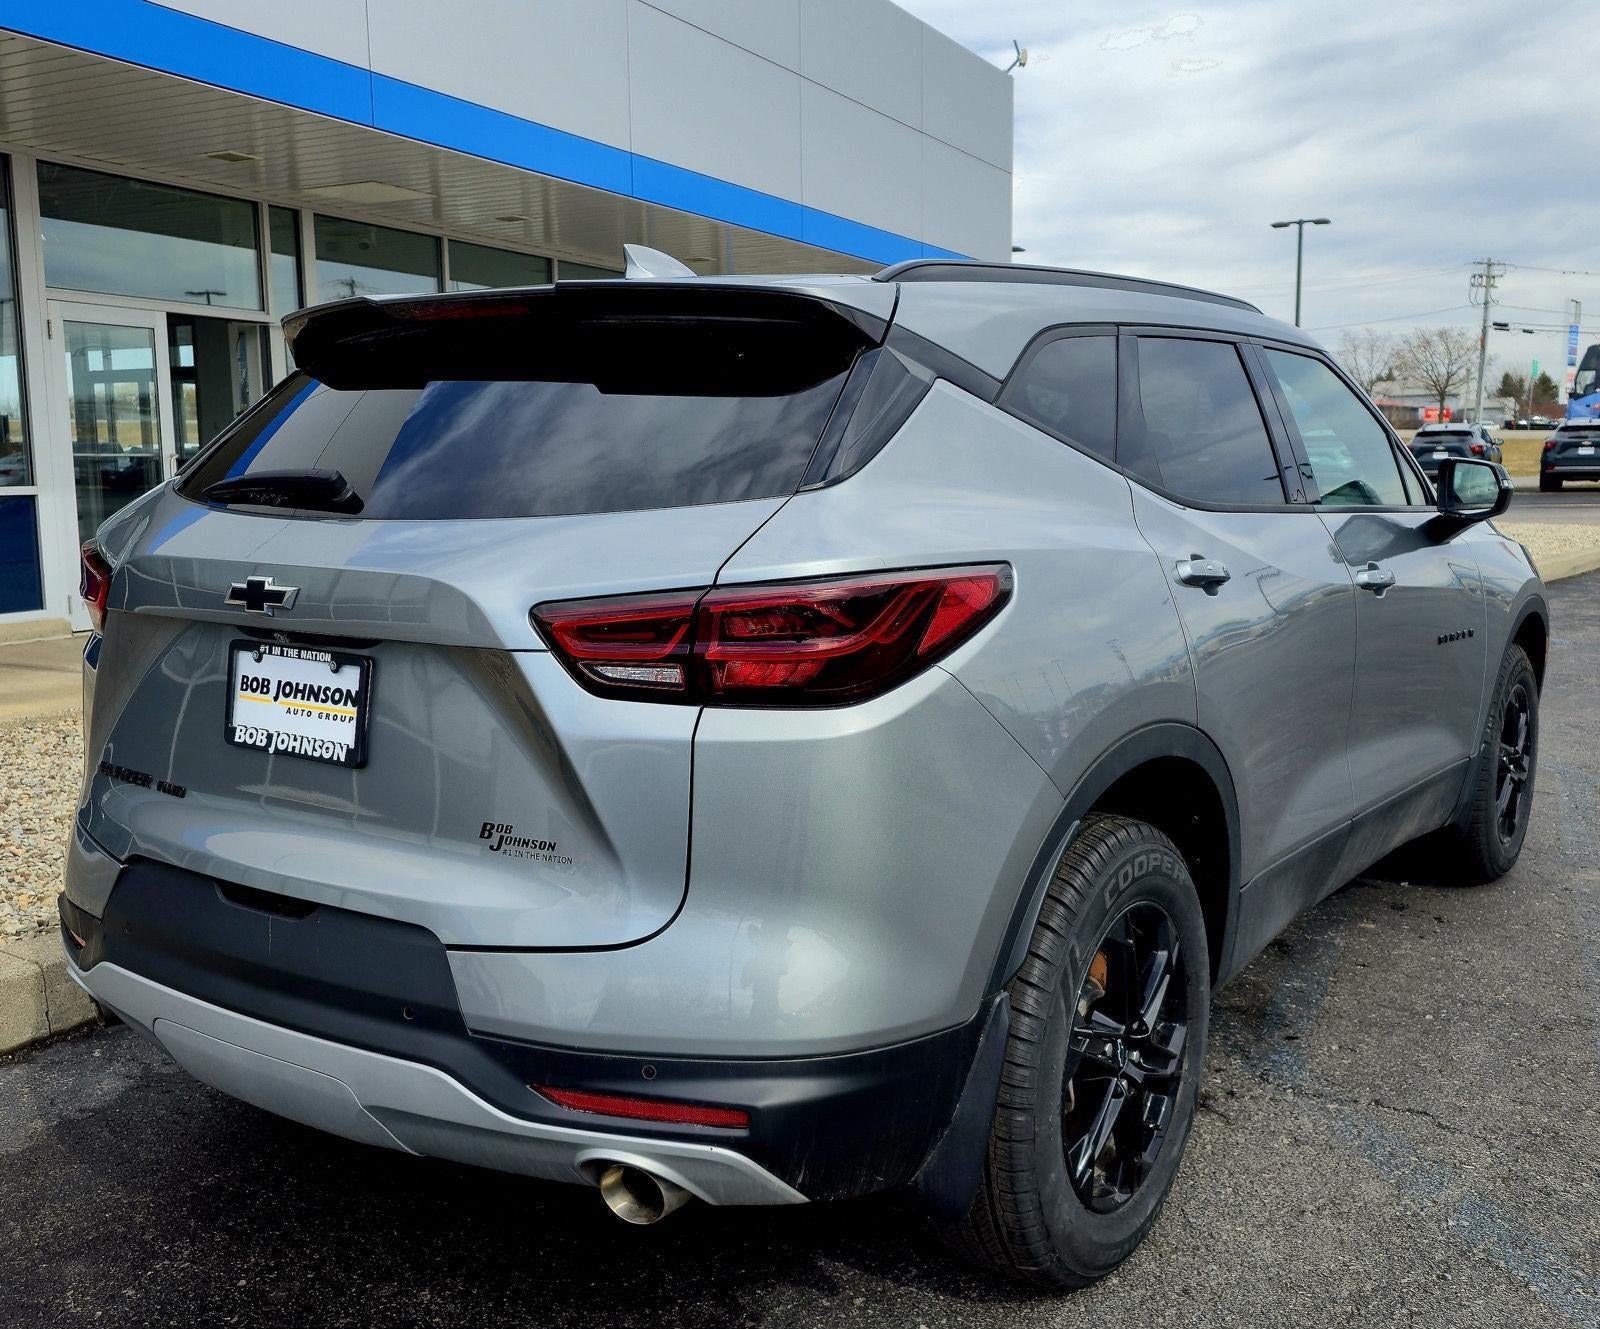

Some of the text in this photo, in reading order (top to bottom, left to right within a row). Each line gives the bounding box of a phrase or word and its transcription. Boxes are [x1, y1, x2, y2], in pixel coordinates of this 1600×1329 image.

[259, 644, 332, 662] #1 IN THE NATION
[240, 674, 359, 707] BOB JOHNSON
[285, 706, 355, 724] AUTO GROUP
[234, 724, 348, 762] BOB JOHNSON
[479, 821, 513, 839] BOB
[489, 835, 557, 852] JOHNSON
[502, 849, 573, 864] #1 IN THE NATION
[1104, 852, 1185, 909] COOPER
